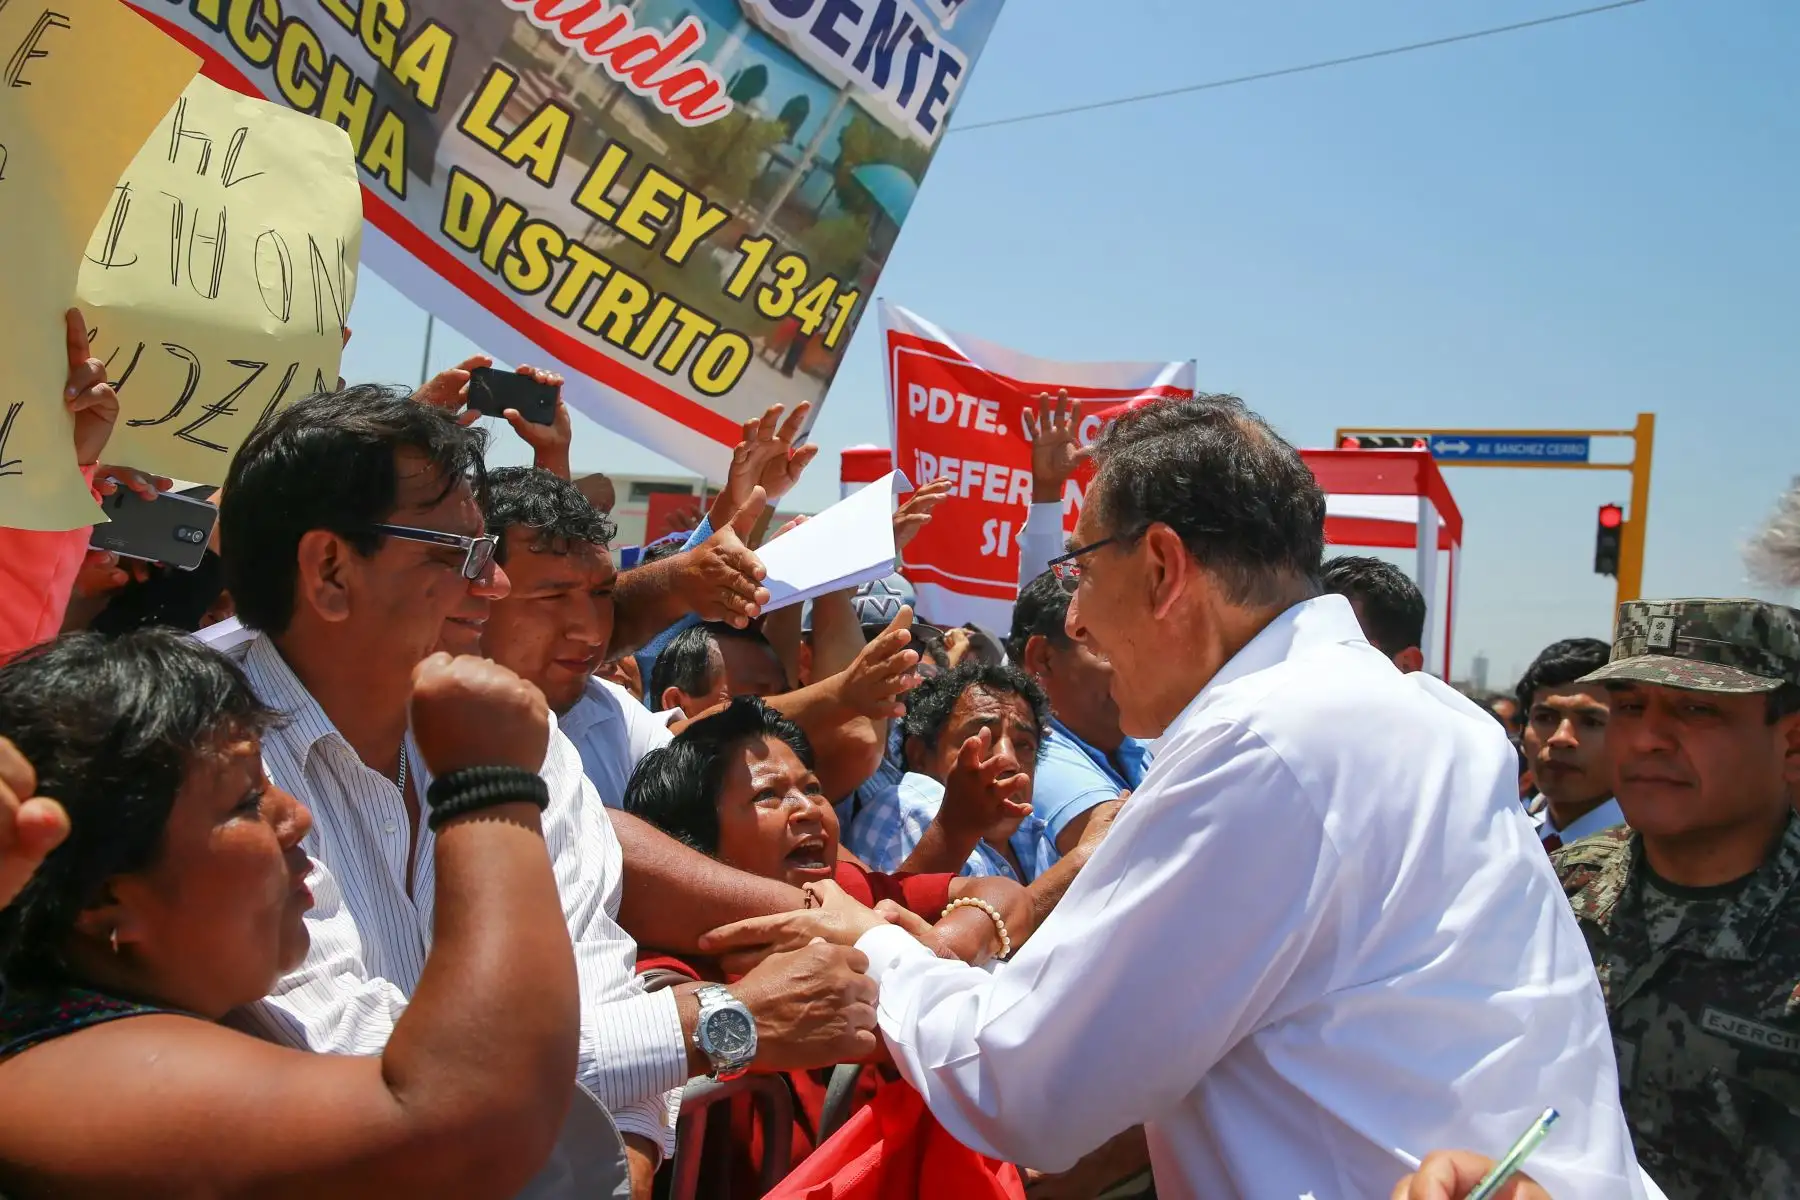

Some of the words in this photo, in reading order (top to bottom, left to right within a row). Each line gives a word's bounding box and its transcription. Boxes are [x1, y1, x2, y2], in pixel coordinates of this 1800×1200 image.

[510, 0, 727, 120] uda
[768, 0, 962, 136] ENTE
[459, 57, 574, 189] LA
[572, 138, 732, 269] LEY
[722, 232, 860, 351] 1341
[441, 165, 754, 397] DISTRITO
[908, 382, 1007, 436] PDTE.
[1494, 443, 1545, 456] SANCHEZ
[1546, 443, 1586, 456] CERRO
[980, 519, 1012, 557] SI
